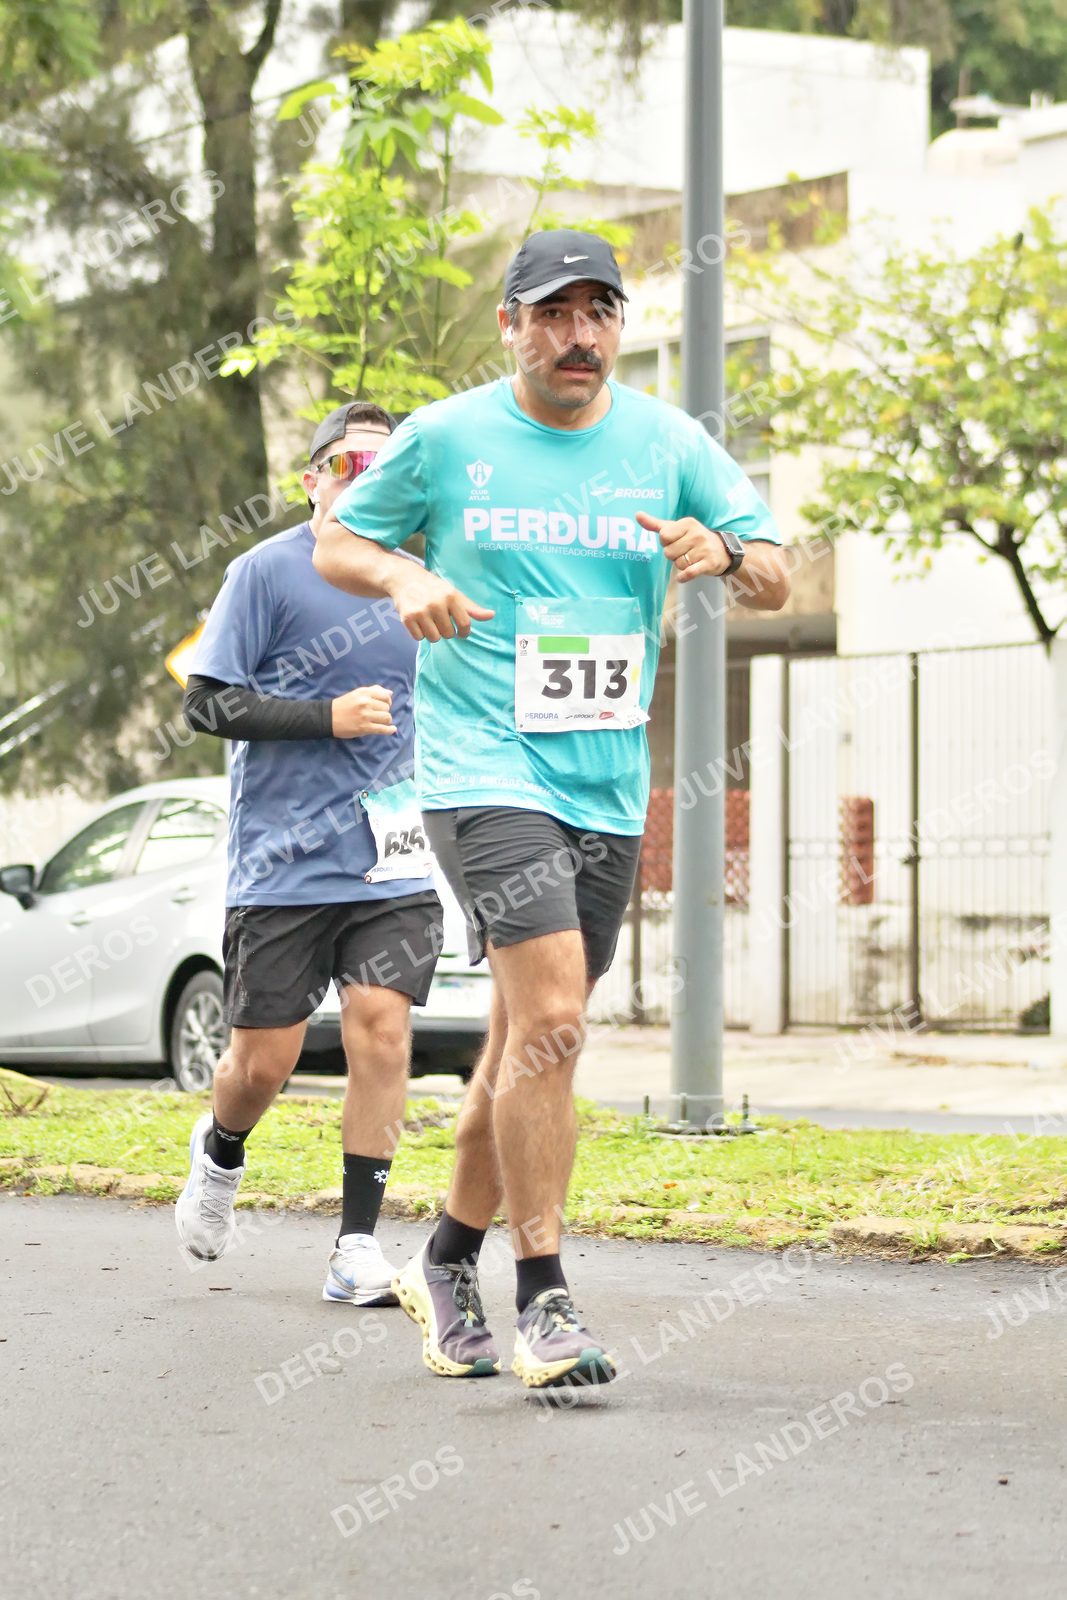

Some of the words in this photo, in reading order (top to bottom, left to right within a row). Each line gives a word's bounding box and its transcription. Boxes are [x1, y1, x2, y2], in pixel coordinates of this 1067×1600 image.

[614, 488, 665, 500] BROOKS
[463, 507, 658, 553] PERDURA
[478, 542, 502, 551] PEGA
[504, 543, 533, 552] PISOS
[540, 546, 604, 559] JUNTEADORES
[541, 659, 628, 699] 313
[525, 712, 559, 720] PERDURA
